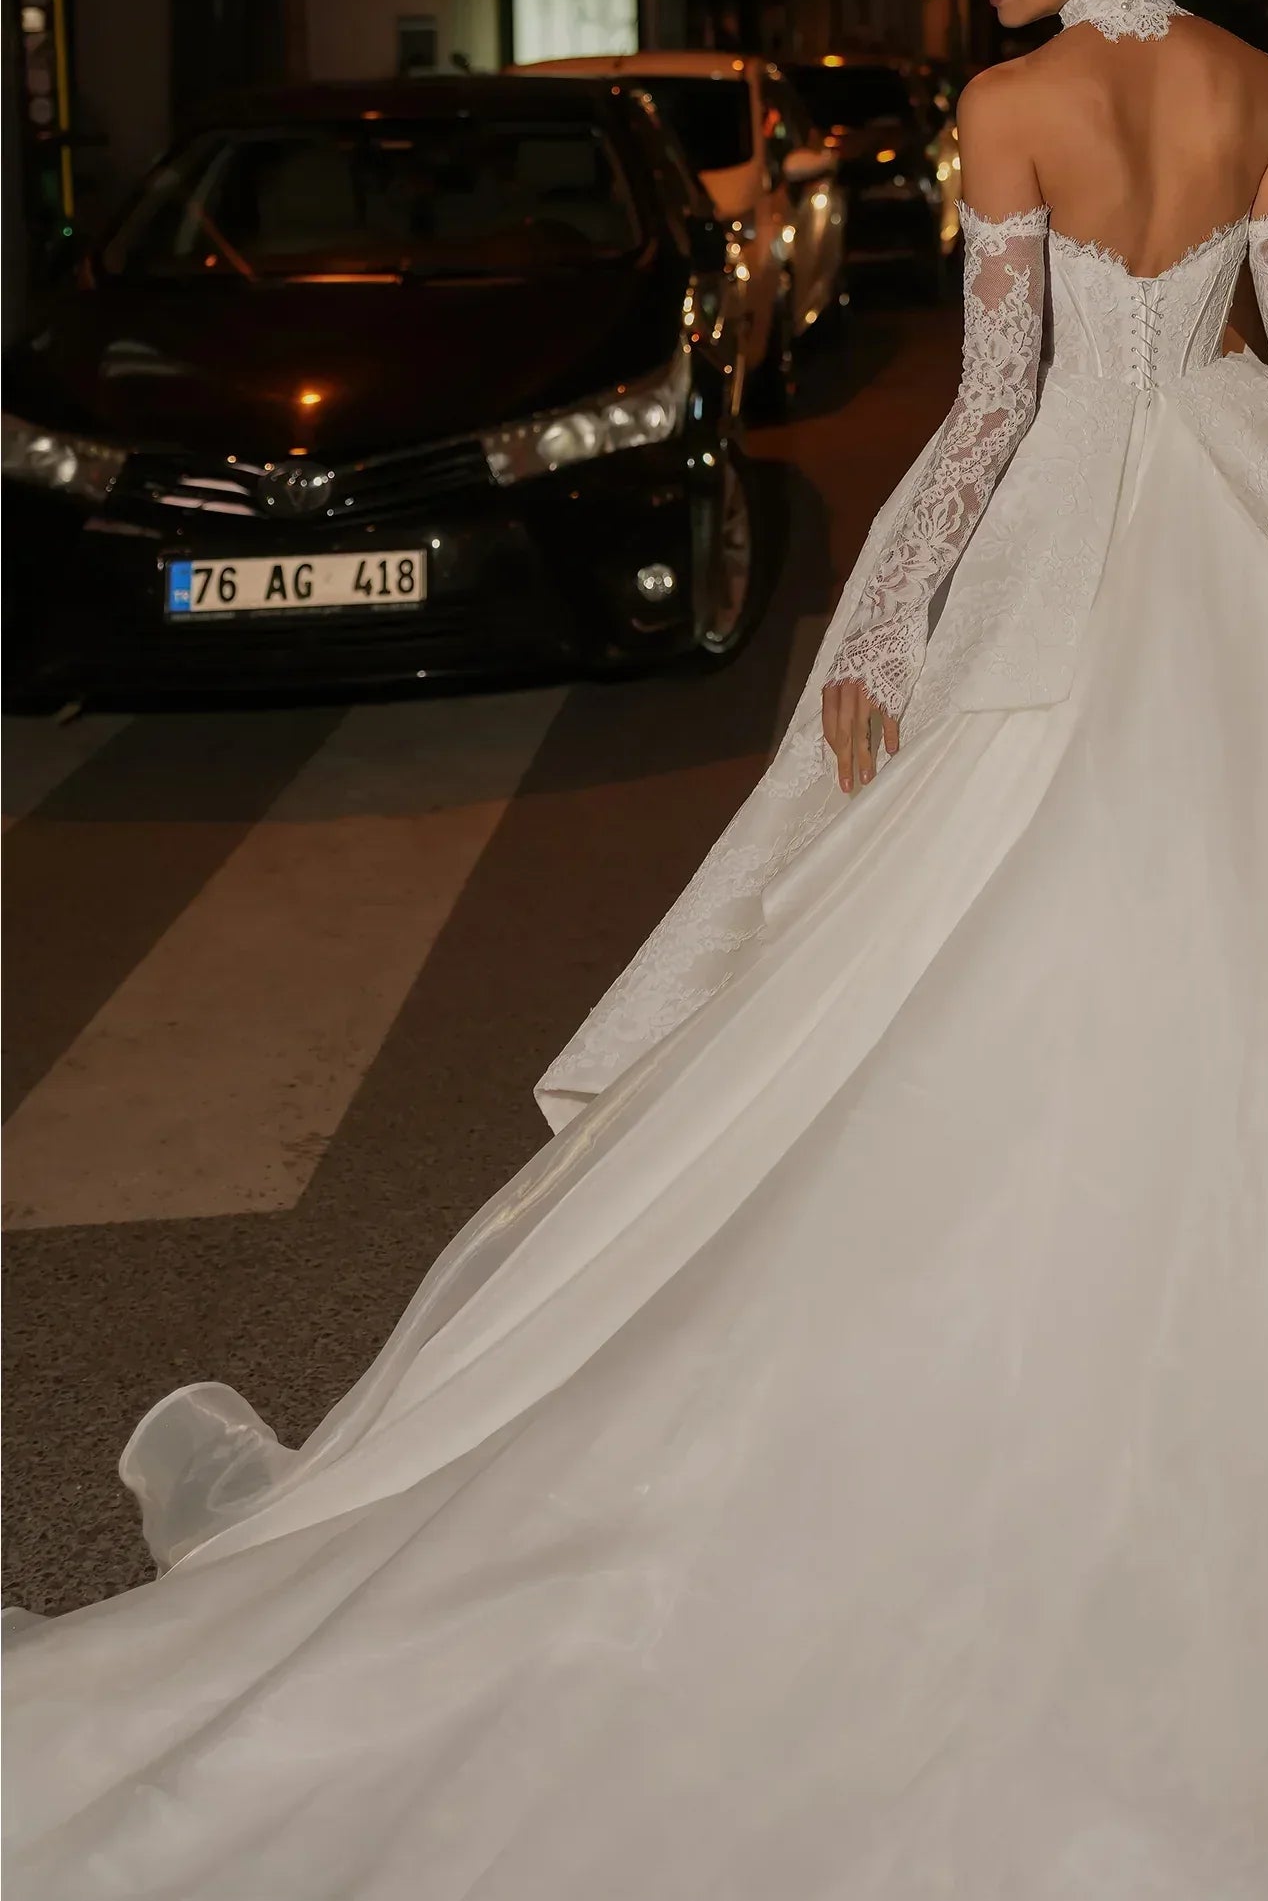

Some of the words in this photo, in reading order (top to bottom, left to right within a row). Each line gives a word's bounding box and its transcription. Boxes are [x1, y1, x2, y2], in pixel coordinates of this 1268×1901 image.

[194, 566, 237, 604] 76
[265, 563, 313, 601] AG
[354, 558, 414, 597] 418
